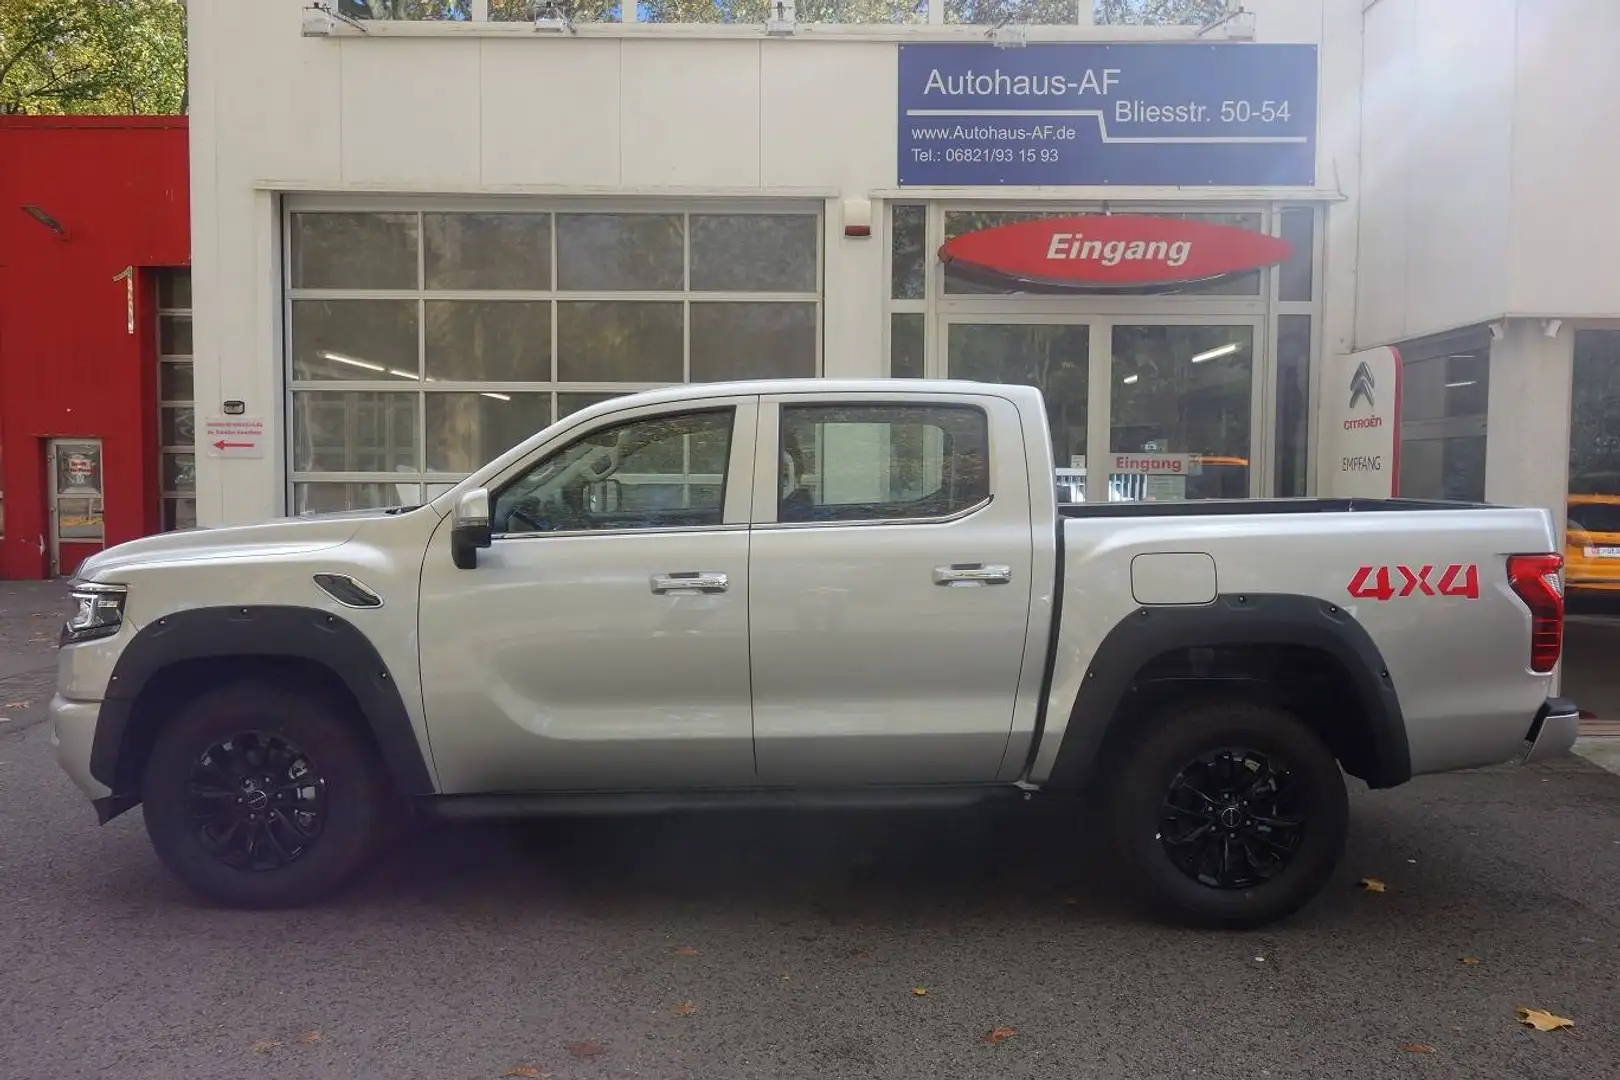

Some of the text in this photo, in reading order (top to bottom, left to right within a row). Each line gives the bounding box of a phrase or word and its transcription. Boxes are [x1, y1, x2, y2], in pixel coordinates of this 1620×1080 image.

[923, 68, 1121, 96] Autohaus-AF
[1115, 99, 1291, 123] Bliesstr. 50-54
[911, 125, 1076, 141] www.Autohaus-AF.de
[911, 147, 1059, 163] Tel.: 06821/93 15 93
[1046, 233, 1192, 267] Eingang
[1115, 456, 1183, 473] Eingang
[1341, 455, 1381, 472] EMPFANG
